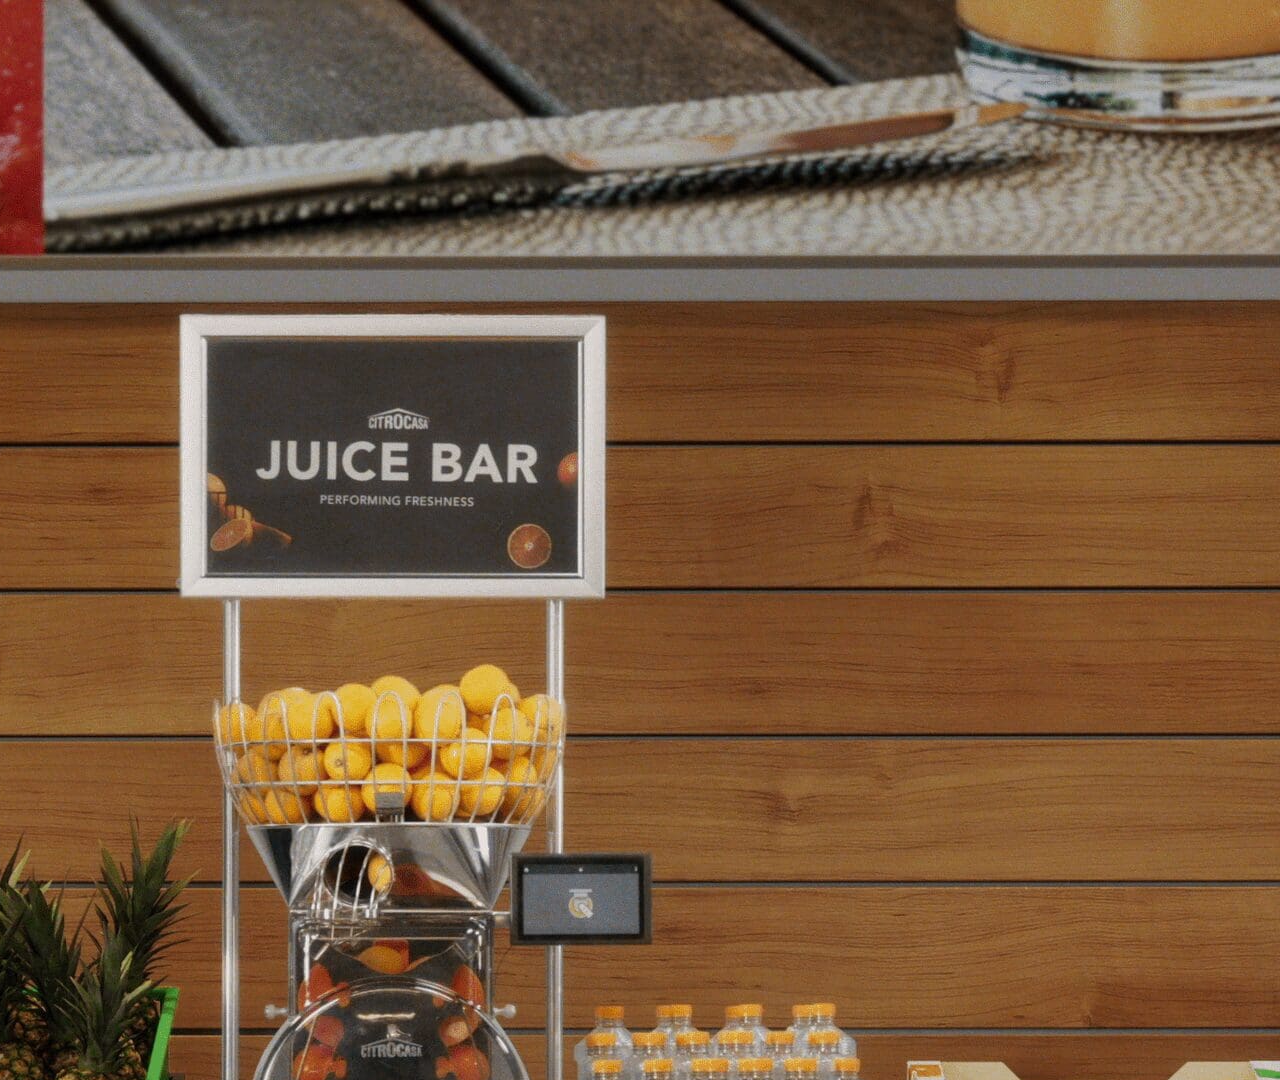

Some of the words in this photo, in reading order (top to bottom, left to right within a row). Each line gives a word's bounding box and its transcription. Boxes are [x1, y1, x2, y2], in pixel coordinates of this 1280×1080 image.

[368, 413, 429, 430] CITROCASA
[256, 440, 409, 481] JUICE
[431, 443, 539, 484] BAR
[319, 494, 401, 507] PERFORMING
[404, 495, 474, 508] FRESHNESS
[360, 1042, 423, 1058] CITROCASA
